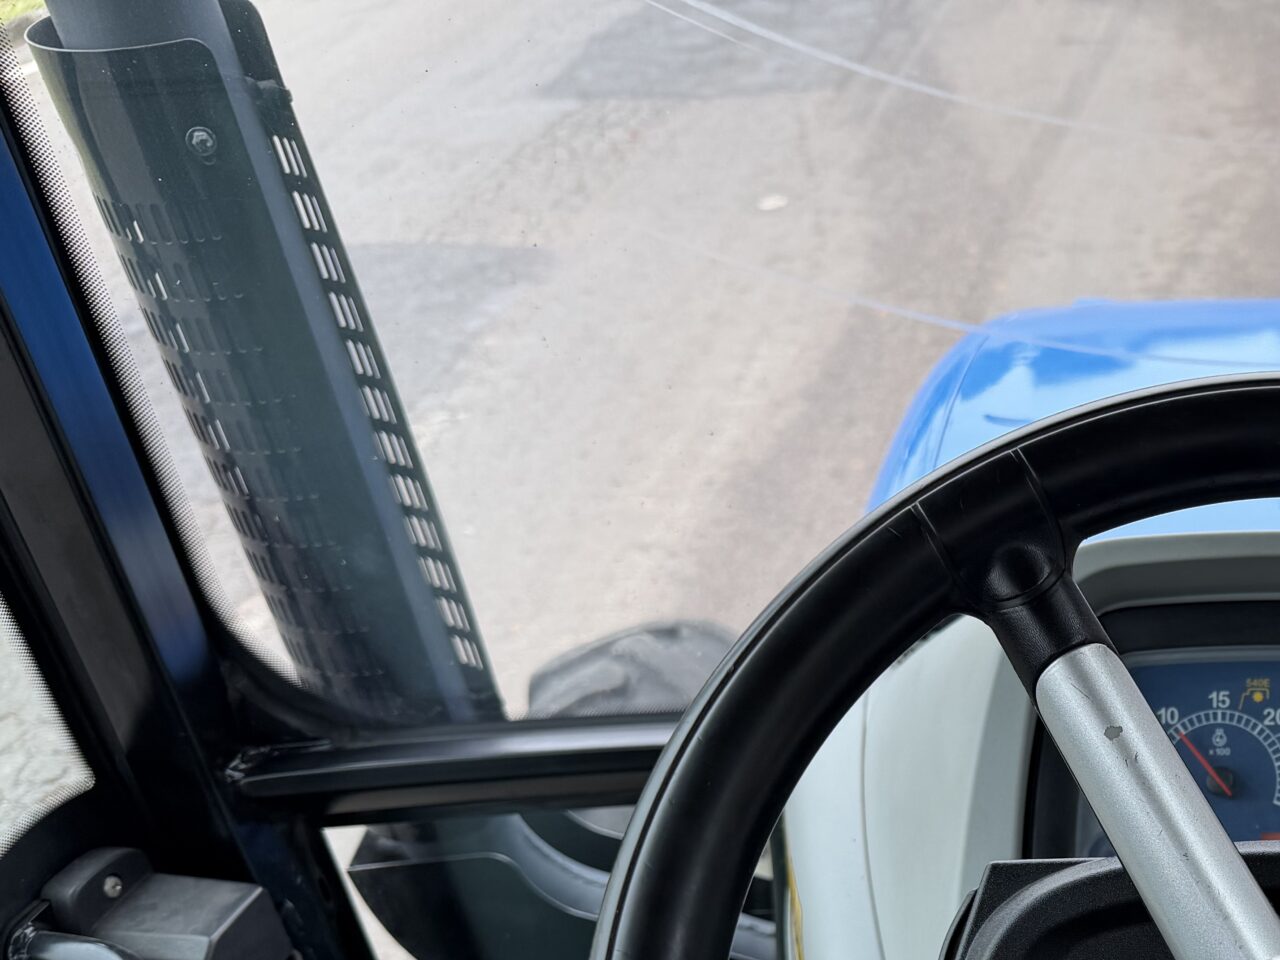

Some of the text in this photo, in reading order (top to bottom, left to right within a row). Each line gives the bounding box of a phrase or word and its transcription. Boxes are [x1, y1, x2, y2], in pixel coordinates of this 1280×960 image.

[1246, 679, 1270, 688] 540E
[1208, 691, 1230, 708] 15
[1157, 707, 1179, 725] 10
